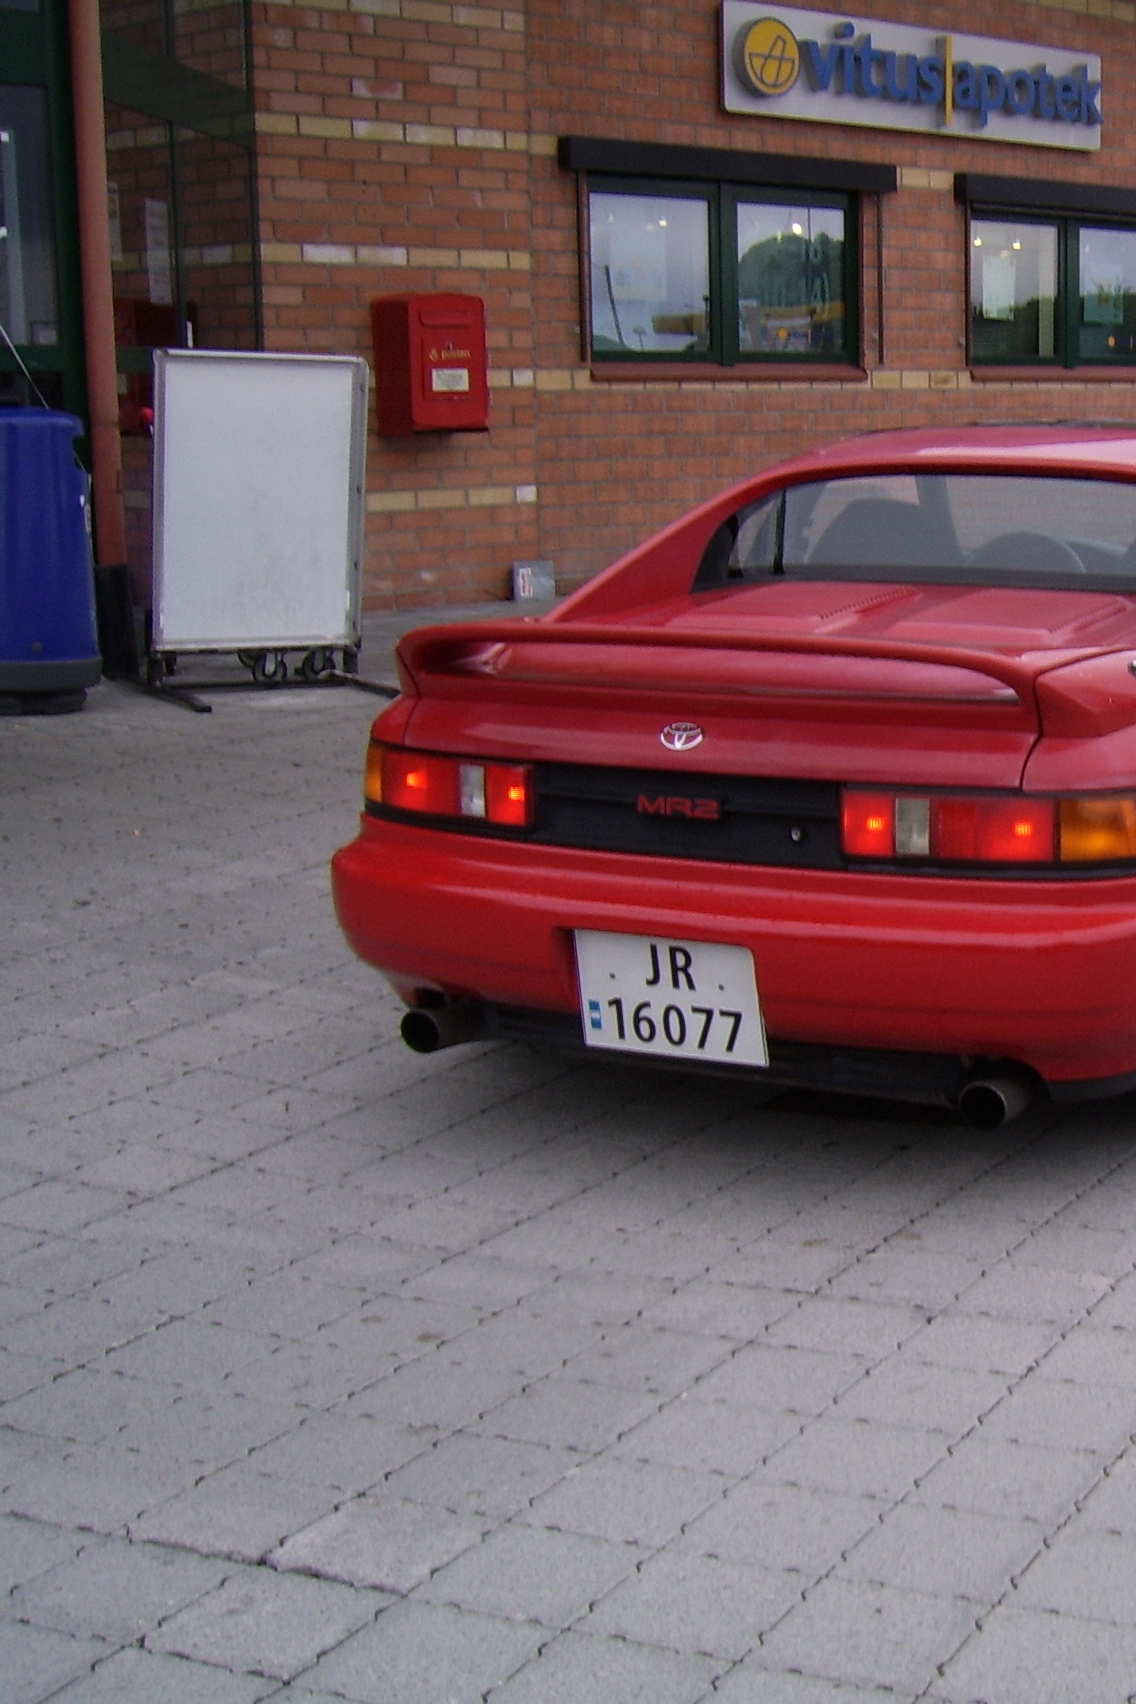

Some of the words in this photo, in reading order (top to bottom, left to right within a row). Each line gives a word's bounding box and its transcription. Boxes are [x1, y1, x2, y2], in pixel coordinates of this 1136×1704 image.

[799, 22, 945, 104] vitus
[951, 60, 1104, 128] apotek
[636, 794, 721, 820] MR2
[645, 943, 696, 991] JR
[607, 997, 743, 1053] 16077
